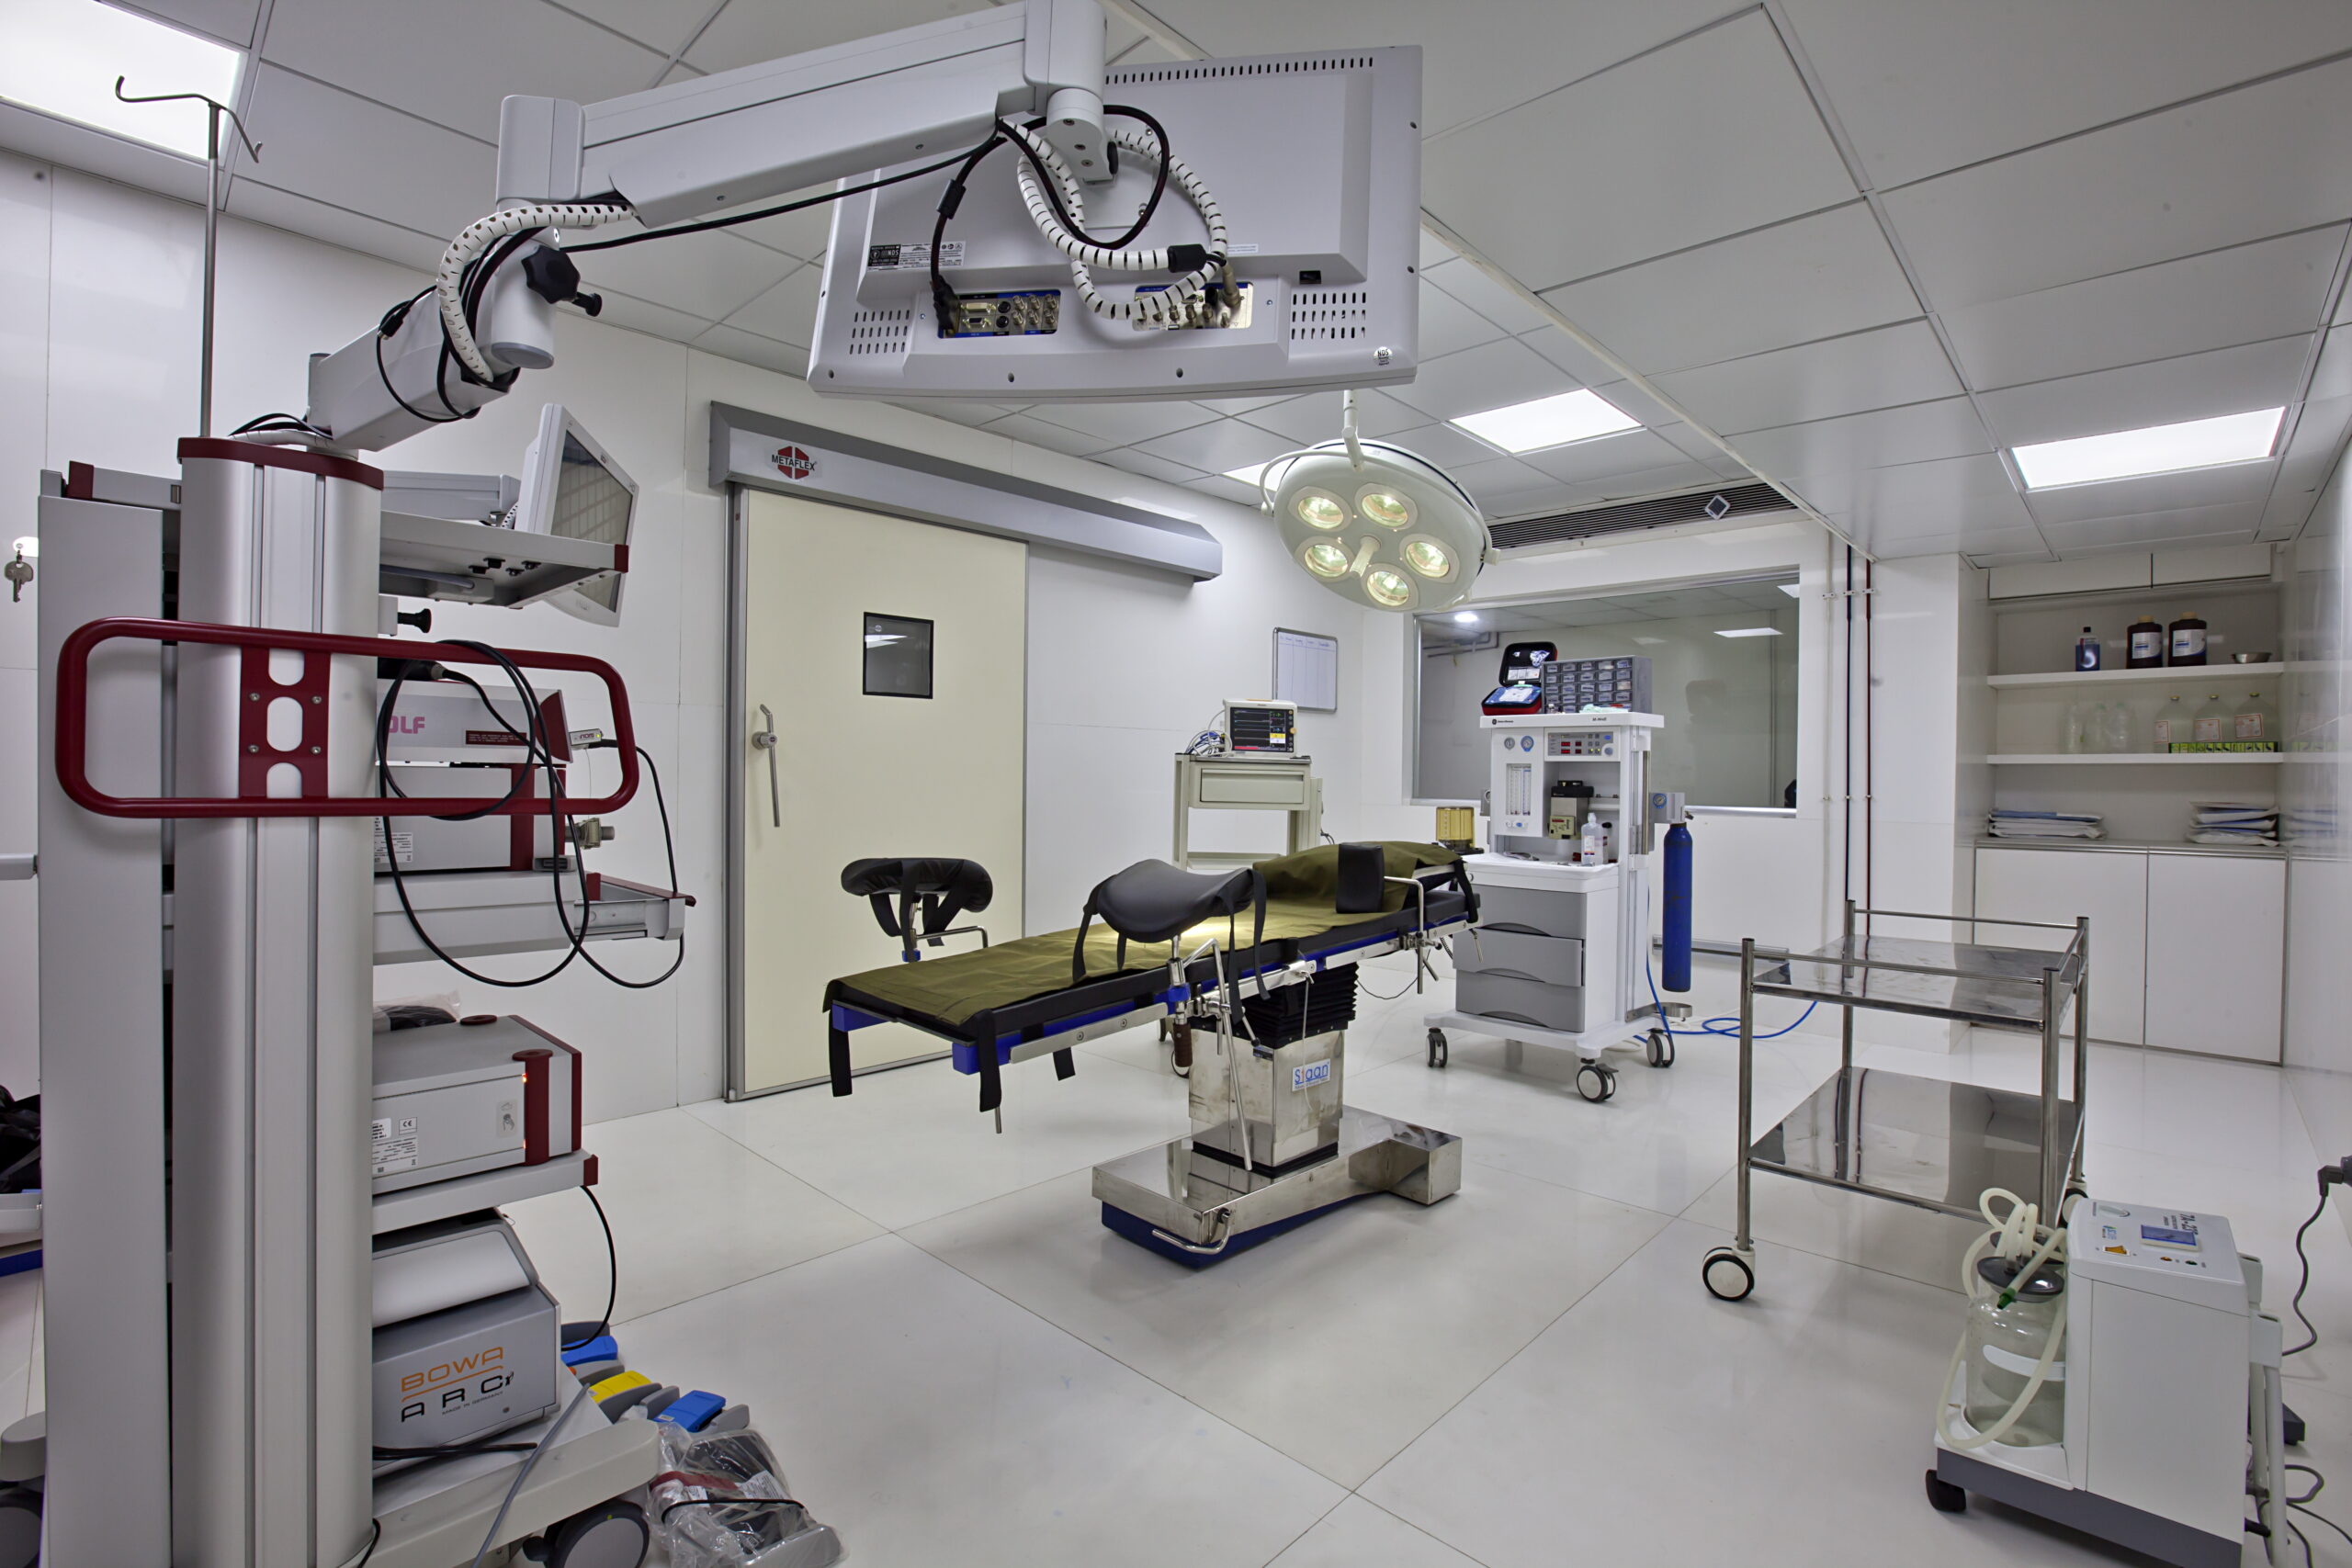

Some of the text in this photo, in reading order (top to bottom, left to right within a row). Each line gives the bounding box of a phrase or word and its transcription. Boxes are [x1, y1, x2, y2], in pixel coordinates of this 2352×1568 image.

[772, 455, 815, 470] METAFLEX
[388, 716, 425, 734] OLF
[401, 1347, 503, 1392] BOWA
